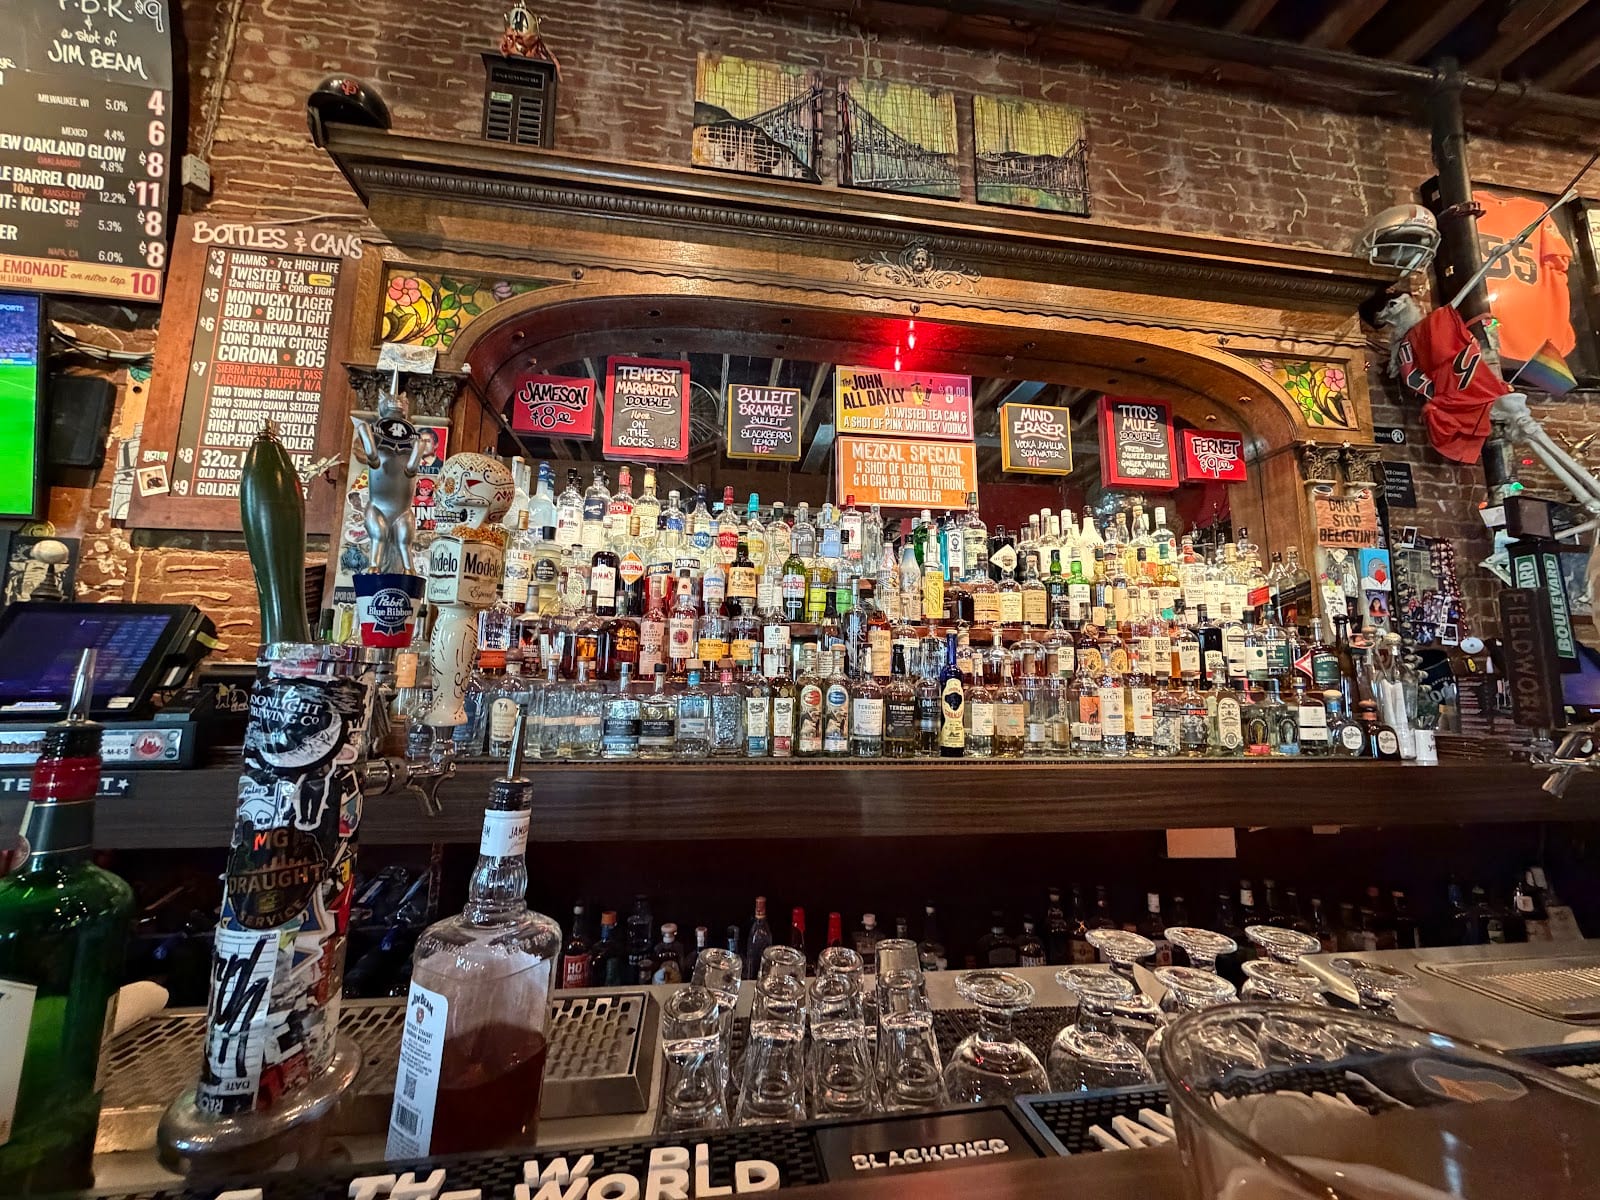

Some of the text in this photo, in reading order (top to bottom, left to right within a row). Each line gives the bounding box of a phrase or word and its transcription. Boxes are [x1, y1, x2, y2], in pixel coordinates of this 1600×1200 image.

[61, 28, 117, 47] a shot of
[48, 39, 148, 80] JIM BEAM
[105, 98, 128, 112] 5.0%
[147, 90, 165, 116] 4
[62, 120, 165, 146] MEXICO 4.4% 6
[23, 136, 164, 178] OAKLAND GLOW $8
[100, 161, 124, 174] 4.8%
[13, 167, 160, 208] BARREL QUAD $11
[13, 182, 126, 204] 10oz 12.2%
[21, 195, 163, 237] KOLSCH $8
[98, 219, 122, 233] 5.3%
[192, 221, 288, 249] BOTTLES
[311, 233, 363, 260] CANS
[98, 250, 123, 264] 6.0%
[139, 241, 165, 268] $8
[211, 250, 340, 274] $3 HAMMS 7oz HIGH LIFE
[8, 276, 33, 284] LEMON
[209, 264, 305, 285] $4 TWISTED TEA
[131, 271, 156, 296] 10
[228, 279, 335, 297] 12oz HIGH LIFE COORS LIGHT
[205, 288, 333, 312] $5 MONTUCKY LAGER
[224, 303, 332, 326] BUD BUD LIGHT
[200, 317, 329, 339] $6 SIERRA NEVADA PALE
[220, 331, 327, 351] LONG DRINK CITRUS
[218, 345, 325, 369] CORONA 805
[193, 361, 323, 380] $7 SIERRA NEVADA TRAIL PASS
[617, 366, 681, 384] TEMPEST
[214, 373, 321, 391] LAGUNITAS HOPPY N/A
[615, 381, 678, 398] MARGARITA
[851, 374, 884, 391] JOHN
[212, 385, 321, 402] TWO TOWNS BRIGHT CIDER
[519, 381, 590, 407] JAMESON
[736, 388, 797, 405] BULLEIT
[843, 387, 906, 410] ALL DAYLY
[211, 397, 319, 413] TOPO STRAW/GUAVA SELTZER
[624, 396, 672, 409] DOUBLE
[738, 402, 794, 417] BRAMBLE
[209, 407, 229, 419] SUN
[271, 411, 317, 424] LEMONADE
[884, 406, 968, 422] A TWISTED TEA CAN &
[1020, 408, 1054, 423] MIND
[1118, 404, 1159, 421] TITO'S
[207, 418, 315, 437] HIGH STELLA
[631, 420, 646, 429] ON
[749, 416, 786, 427] BULLEIT
[843, 418, 969, 435] A SHOT OF PINK WHITNEY VODKA
[1014, 421, 1066, 438] ERASER
[1122, 418, 1159, 433] MULE
[626, 428, 650, 437] THE
[740, 428, 793, 443] BLACKBERRY
[1119, 431, 1163, 442] DOUBLE
[618, 436, 655, 447] ROCKS
[752, 438, 779, 447] LEMON
[1191, 436, 1241, 455] FERNET
[179, 448, 193, 464] $8
[200, 449, 237, 468] 32oz
[851, 442, 965, 465] MEZCAL SPECIAL
[1153, 453, 1168, 461] LIME
[198, 468, 216, 479] OLD
[856, 462, 962, 478] A SHOT OF ILEGAL MEZCAL
[174, 480, 188, 496] $9
[861, 475, 966, 490] A CAN OF STIEGL ZITRONE
[879, 487, 942, 503] LEMON RADLER
[1332, 513, 1362, 528] STOP
[378, 595, 405, 608] Pabst
[1546, 560, 1575, 653] BOULEVARD
[368, 606, 413, 617] Blue Ribbon
[1507, 592, 1541, 724] FIELDWORK
[229, 864, 325, 895] DRAUGHT
